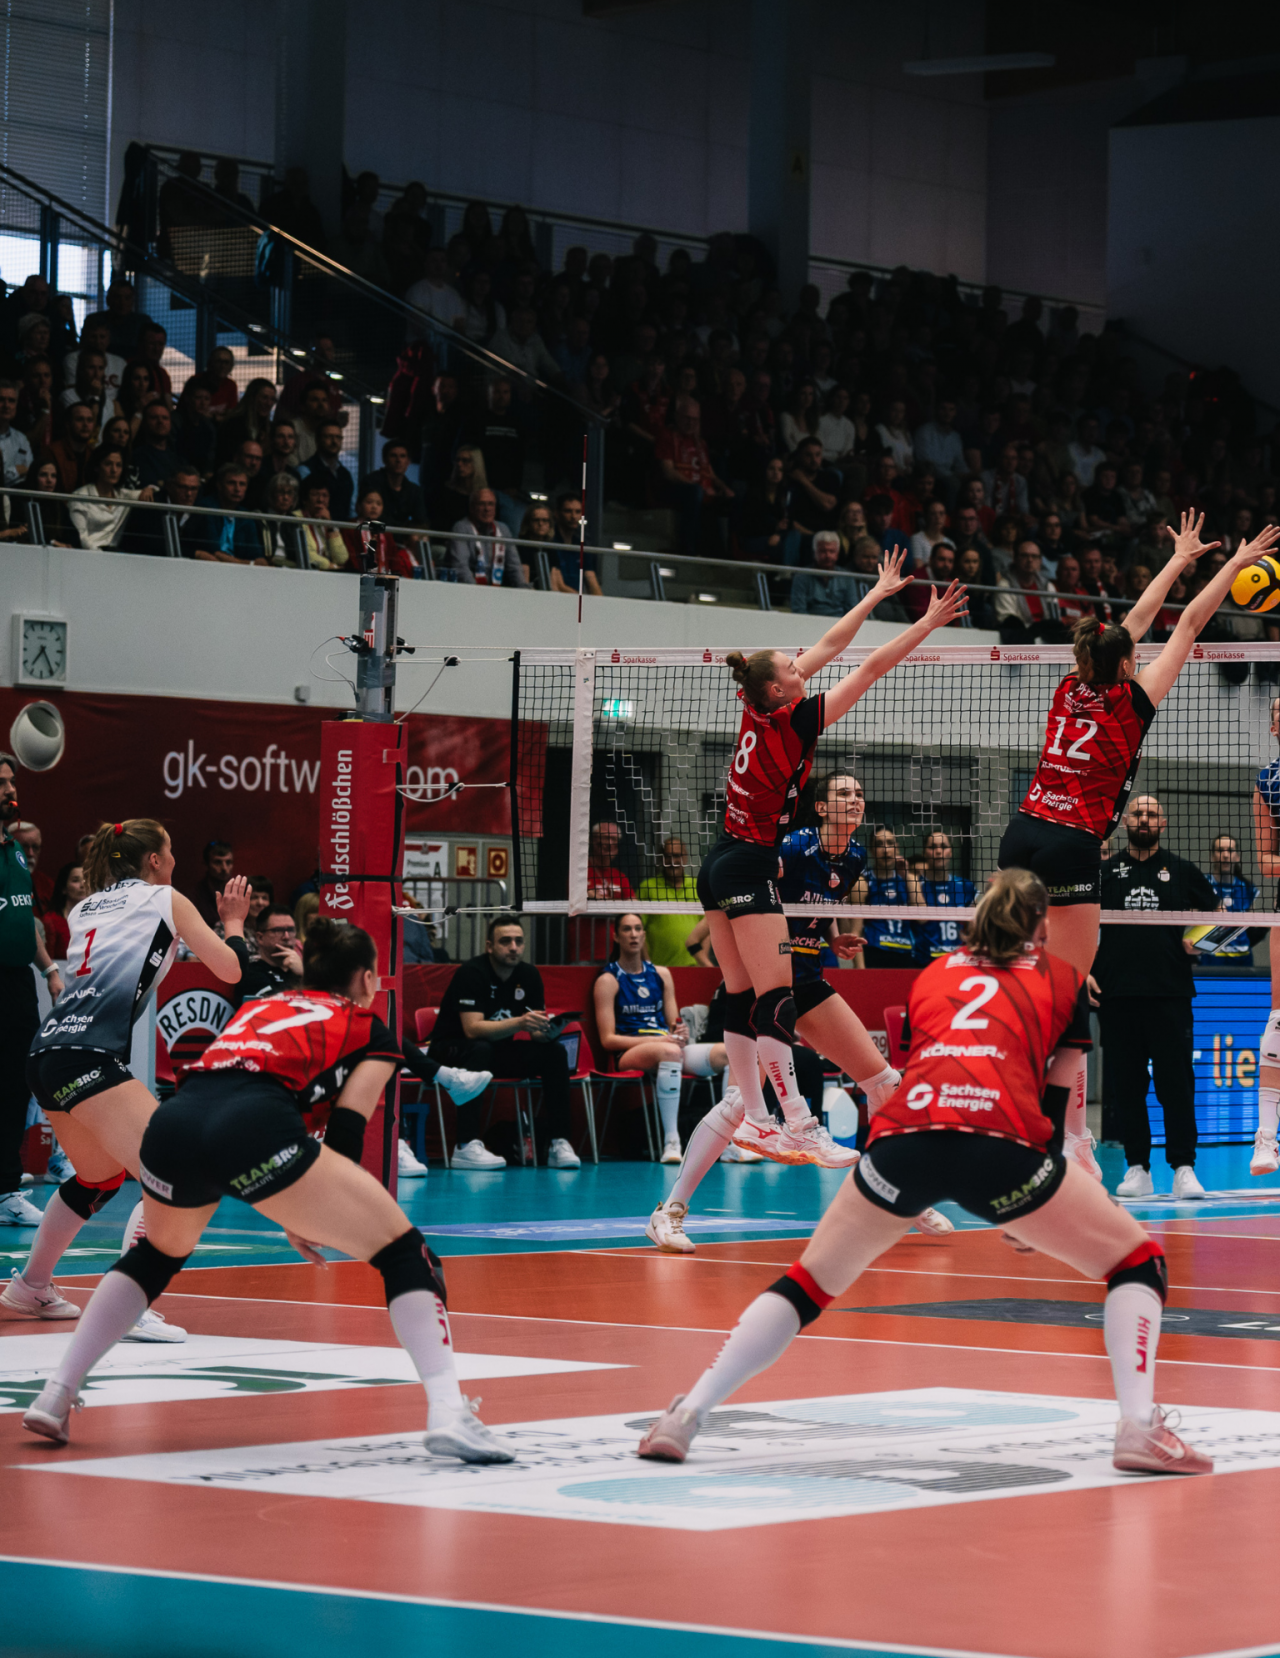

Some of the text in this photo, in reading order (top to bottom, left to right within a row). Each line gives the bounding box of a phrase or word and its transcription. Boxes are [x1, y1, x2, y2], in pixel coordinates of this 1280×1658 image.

[623, 654, 657, 665] Sparkasse
[1003, 652, 1040, 664] Sparkasse
[1206, 650, 1245, 661] Sparkasse
[734, 730, 758, 775] 8
[1047, 715, 1099, 761] 12
[324, 749, 355, 910] Fedschlößchen
[1047, 883, 1094, 894] TEAMBRO
[939, 921, 958, 941] 16
[75, 928, 97, 978] 1
[158, 996, 234, 1040] RESDN
[217, 1000, 335, 1036] 17
[950, 975, 999, 1030] 2
[920, 1043, 998, 1060] KÖRNER
[53, 1066, 102, 1102] TEAMBRO
[940, 1083, 1001, 1099] Sachsen
[937, 1096, 994, 1112] Energie
[229, 1143, 299, 1191] TEAMBRO
[989, 1157, 1054, 1209] TEAMBRO
